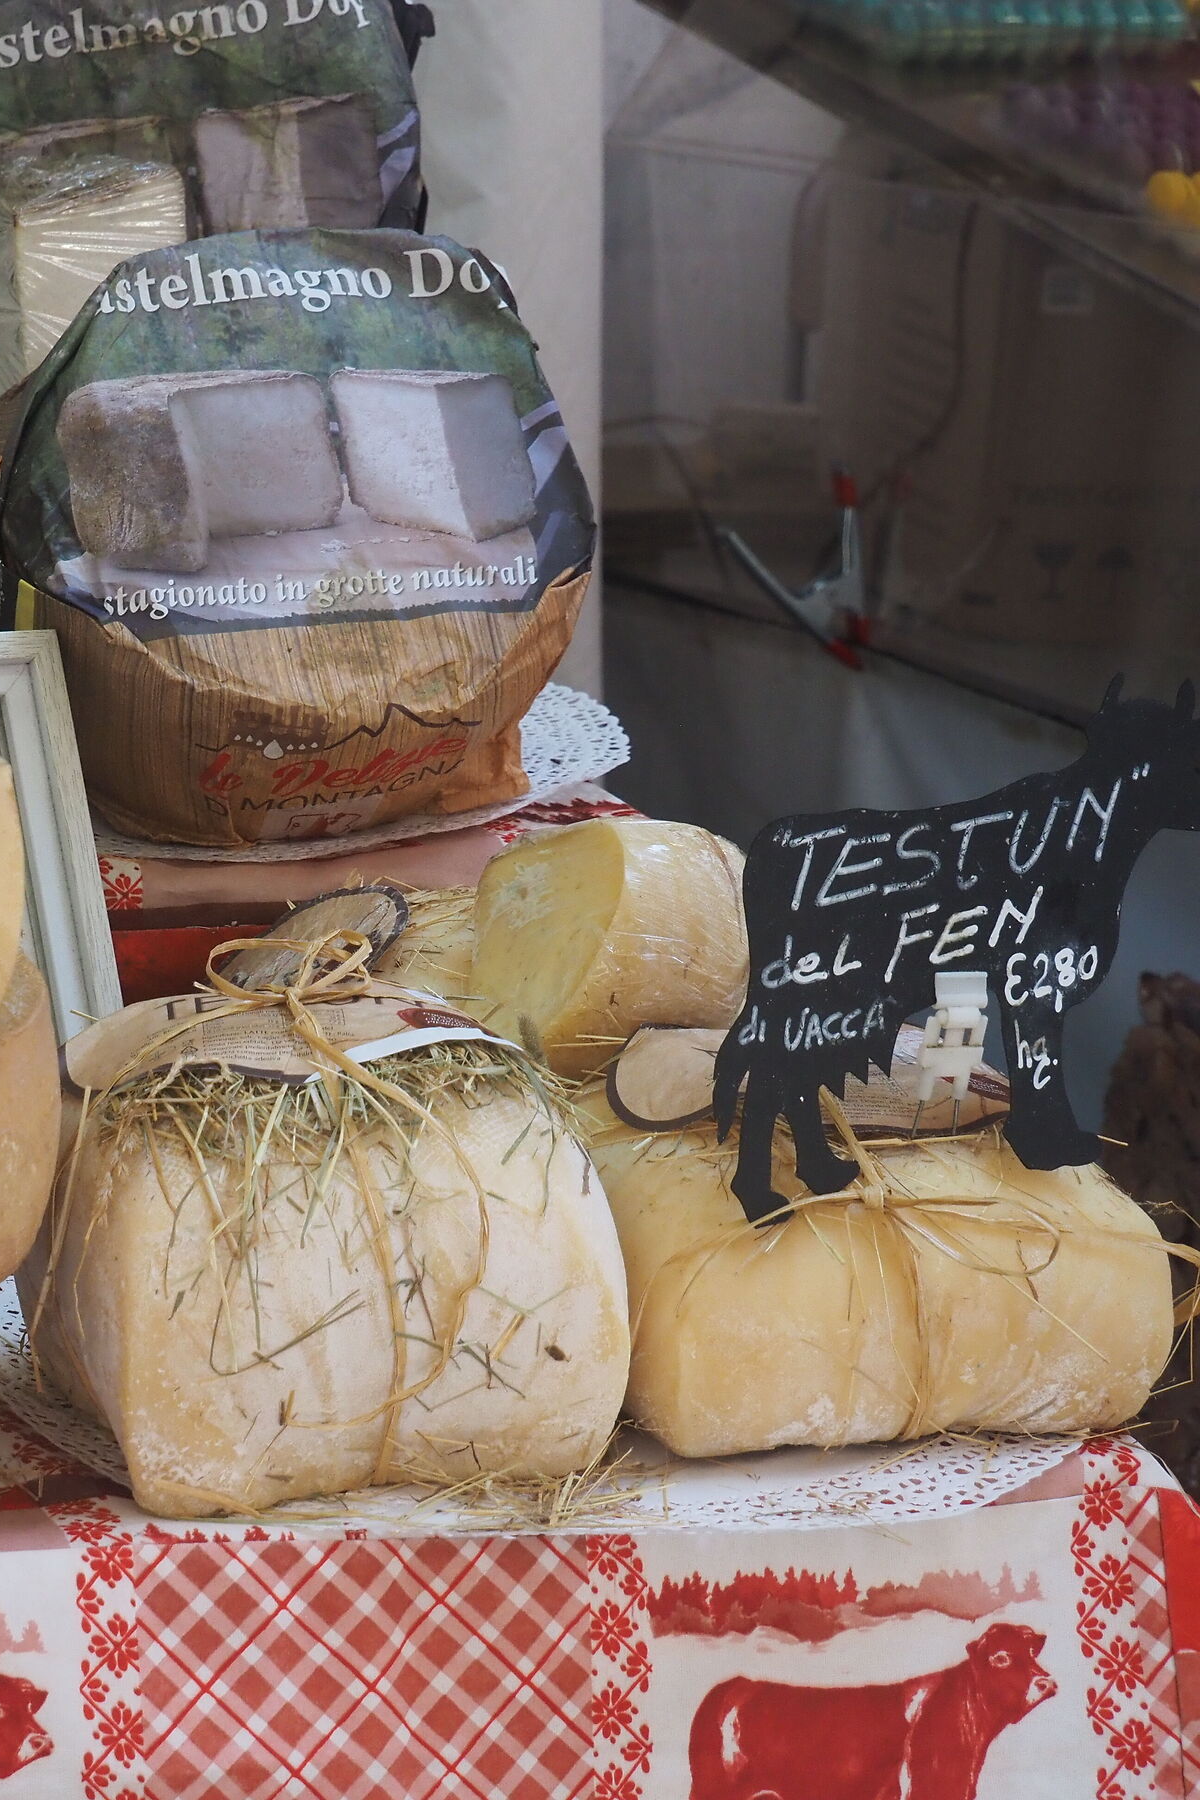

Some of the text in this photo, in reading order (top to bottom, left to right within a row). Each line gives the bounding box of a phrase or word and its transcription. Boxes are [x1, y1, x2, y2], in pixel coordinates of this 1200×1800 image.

[403, 248, 510, 310] Do
[103, 555, 539, 620] stagionato in grotte naturali
[884, 885, 1043, 983] FEN
[738, 1000, 887, 1052] di VACCA
